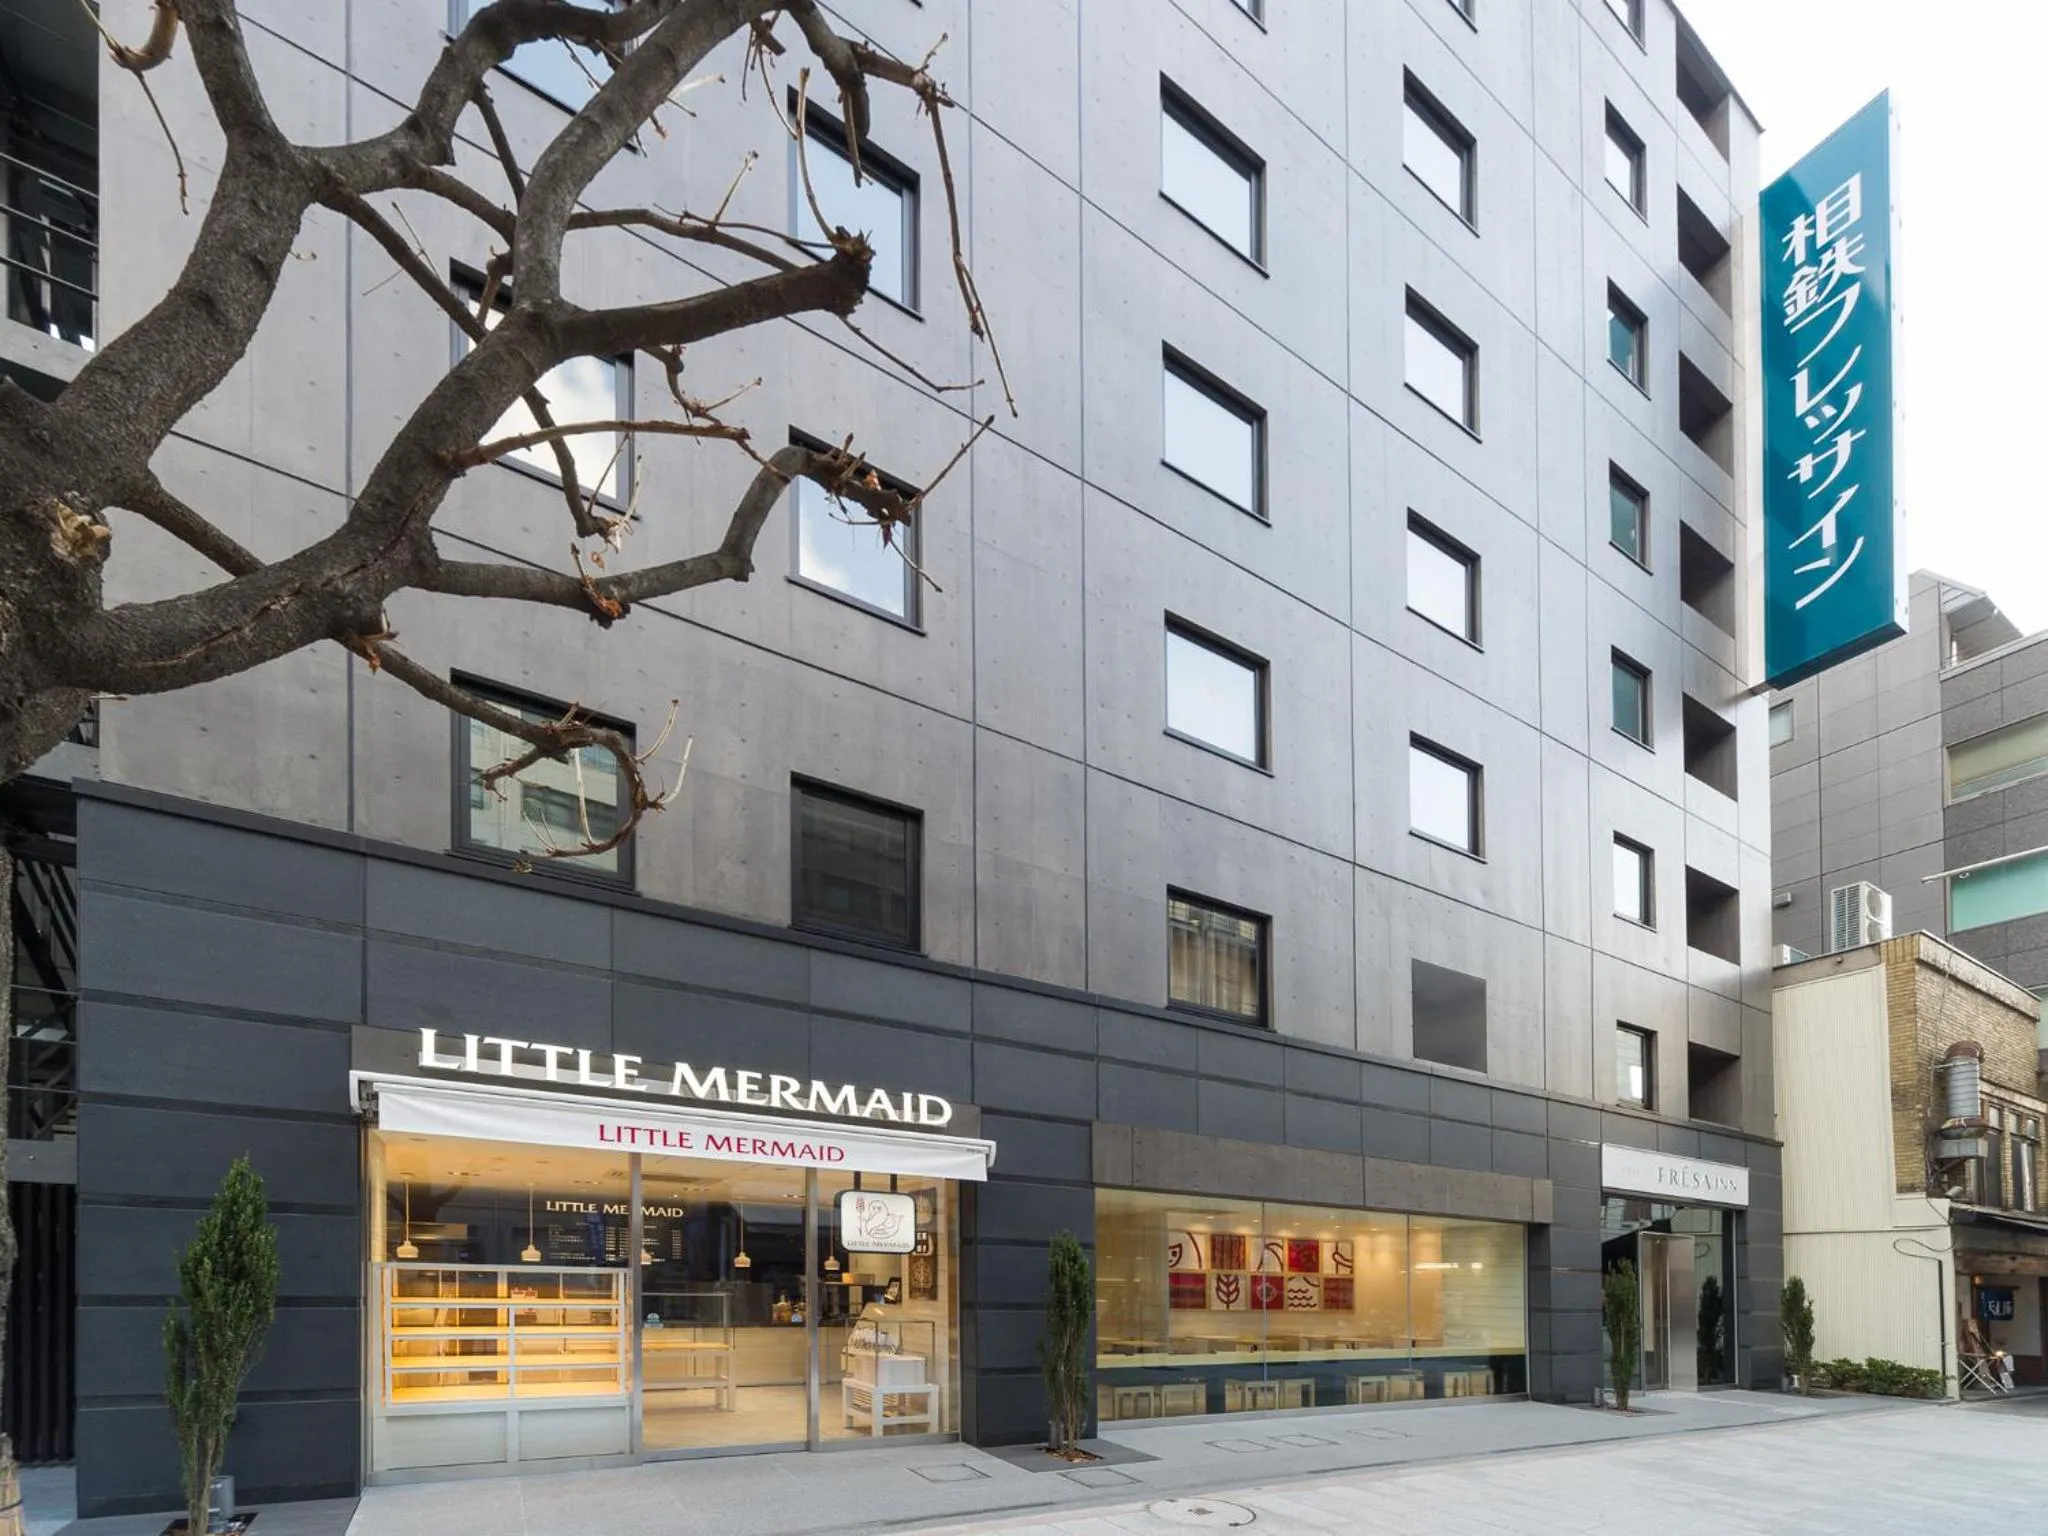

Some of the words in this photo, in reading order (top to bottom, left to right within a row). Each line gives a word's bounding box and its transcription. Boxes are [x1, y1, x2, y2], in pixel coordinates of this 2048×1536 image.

[418, 1027, 648, 1092] LITTLE
[670, 1061, 953, 1126] MERMAID
[599, 1123, 693, 1150] LITTLE
[705, 1134, 845, 1162] MERMAID
[546, 1200, 598, 1214] LITTLE
[603, 1203, 684, 1218] MEMAID
